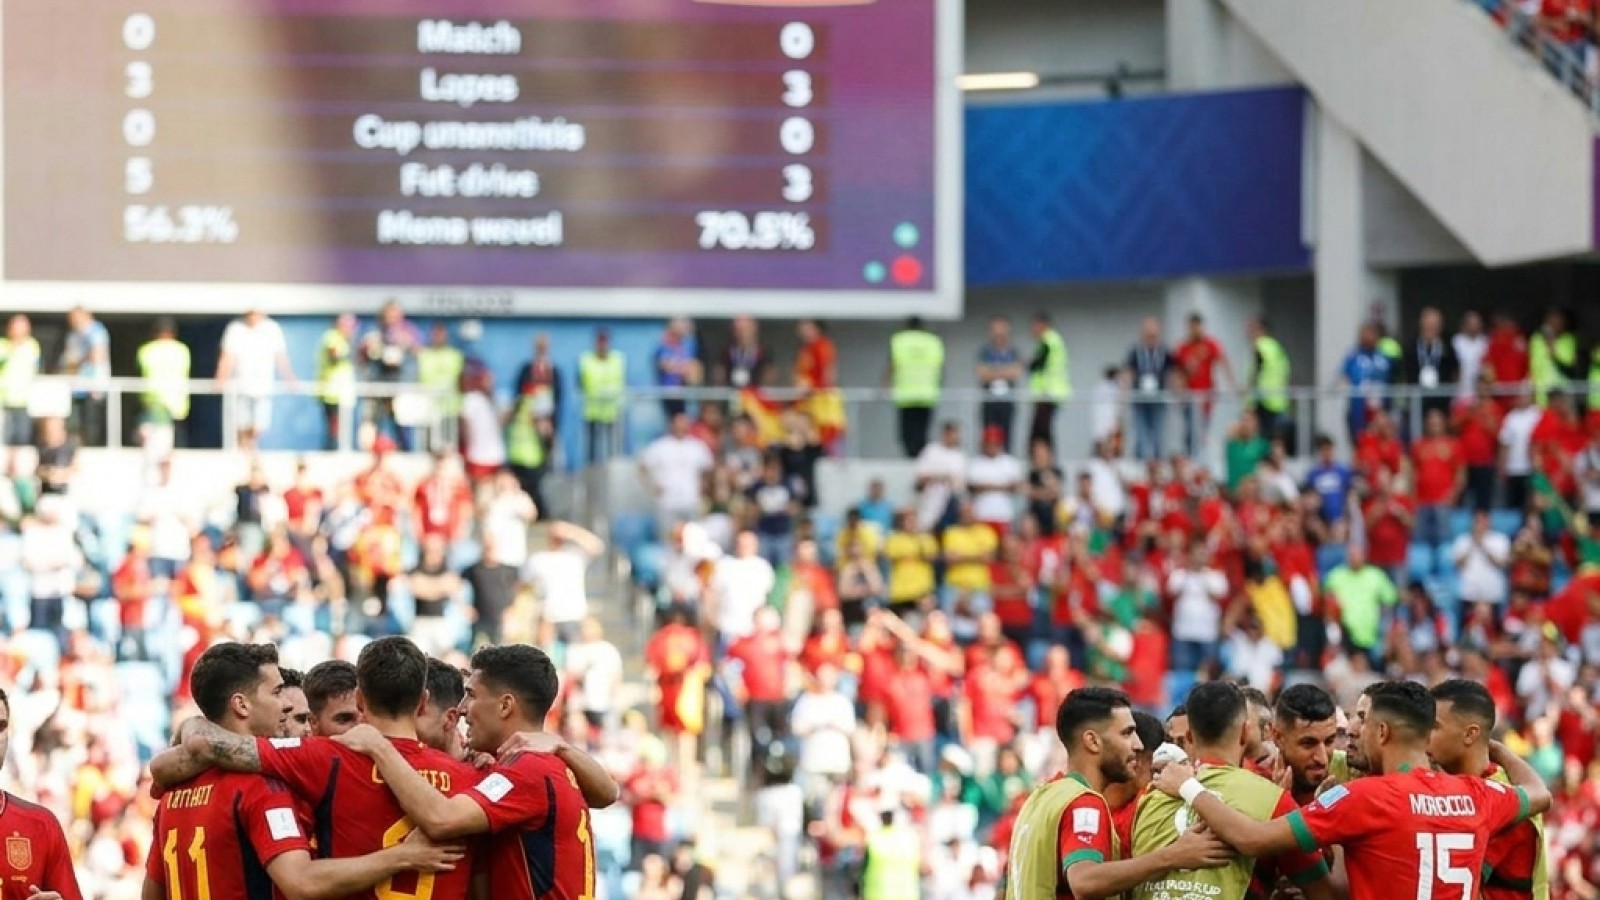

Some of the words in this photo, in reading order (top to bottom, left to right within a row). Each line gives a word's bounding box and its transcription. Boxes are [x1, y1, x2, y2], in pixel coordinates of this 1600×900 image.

[123, 14, 155, 50] 0
[417, 19, 522, 54] Match
[780, 22, 814, 59] 0
[125, 61, 152, 98] 3
[783, 70, 813, 107] 3
[123, 109, 155, 146] 0
[353, 113, 421, 155] Cup
[780, 116, 814, 154] 0
[783, 164, 813, 202] 3
[696, 211, 815, 249] 70.5%
[164, 826, 211, 900] 11
[1416, 832, 1475, 900] 15
